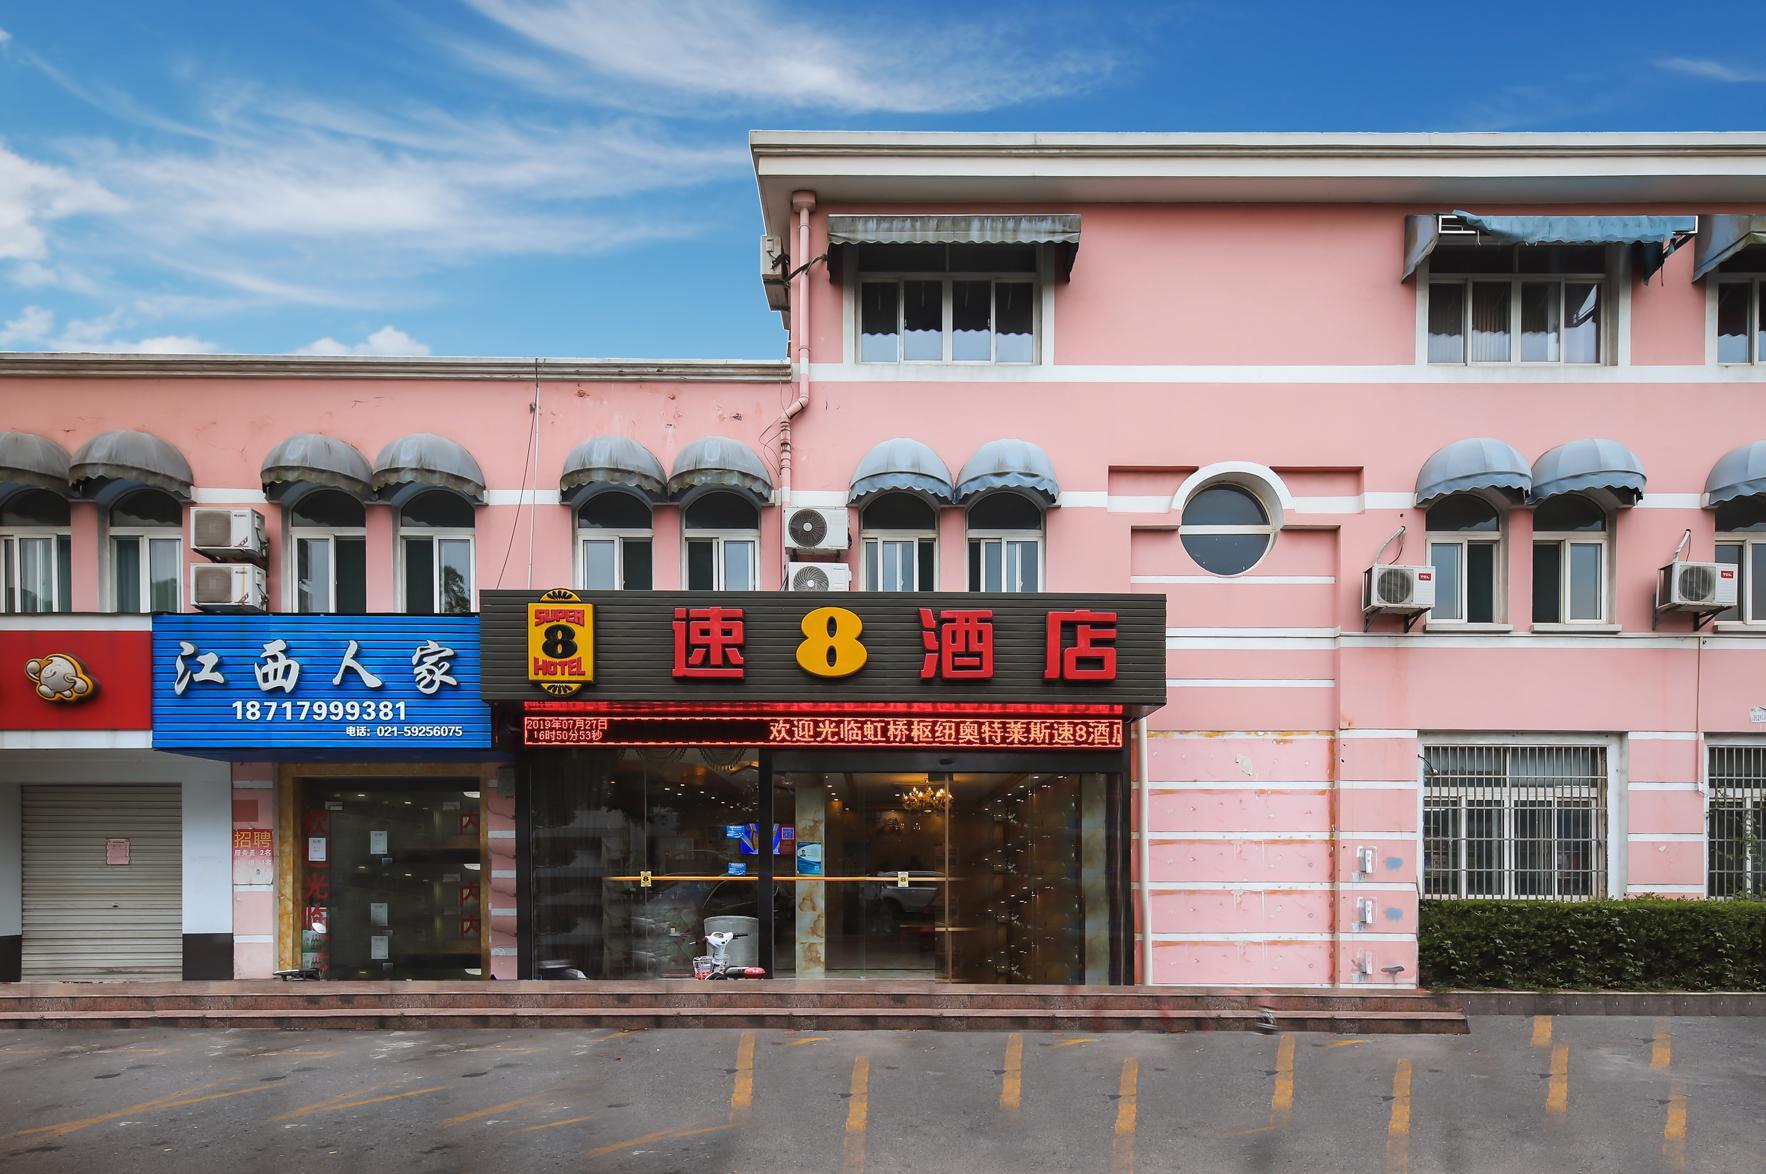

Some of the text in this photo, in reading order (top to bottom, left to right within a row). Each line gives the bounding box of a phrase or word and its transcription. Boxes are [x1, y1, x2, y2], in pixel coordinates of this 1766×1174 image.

[534, 609, 584, 627] SUPER
[542, 624, 577, 659] 8
[672, 606, 1117, 680] 速8酒店
[174, 639, 457, 695] 江西人家
[534, 656, 585, 676] HOTEL
[232, 701, 406, 720] 18717999381
[376, 726, 463, 737] 021-59256075
[234, 831, 272, 848] 招聘
